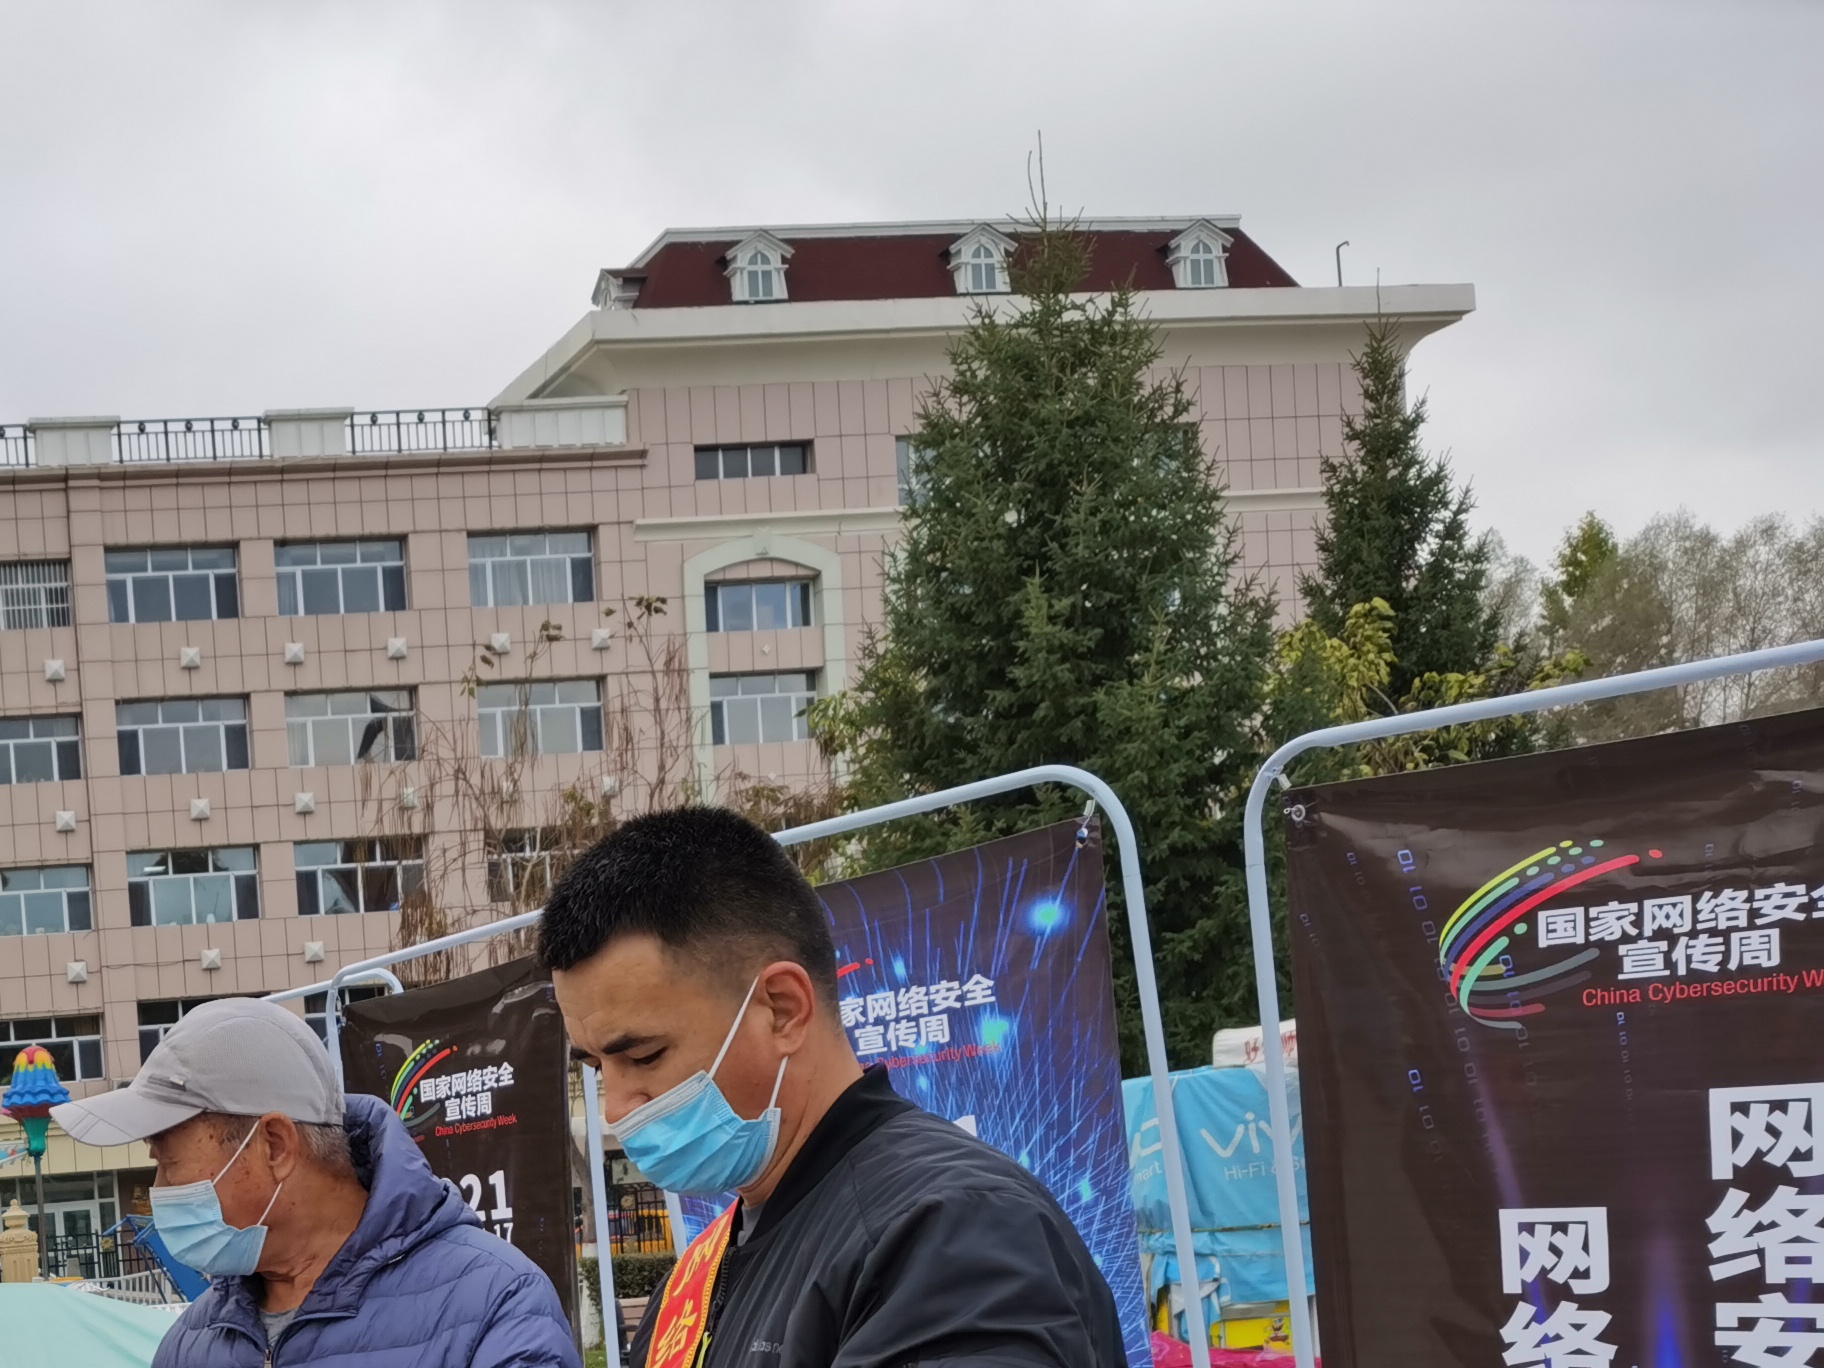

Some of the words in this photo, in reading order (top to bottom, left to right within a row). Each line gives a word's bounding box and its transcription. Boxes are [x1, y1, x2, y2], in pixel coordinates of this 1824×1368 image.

[1617, 928, 1781, 980] 宣传周
[838, 973, 996, 1027] 家网络安全
[1582, 986, 1641, 1006] China
[1648, 974, 1799, 1004] Cybersecurity
[854, 1013, 951, 1056] 宣传周
[419, 1062, 514, 1103] 国家网络安全
[435, 1125, 454, 1137] China
[454, 1117, 497, 1135] Cybersecurity
[497, 1113, 517, 1127] Week
[445, 1091, 493, 1122] 宣传周
